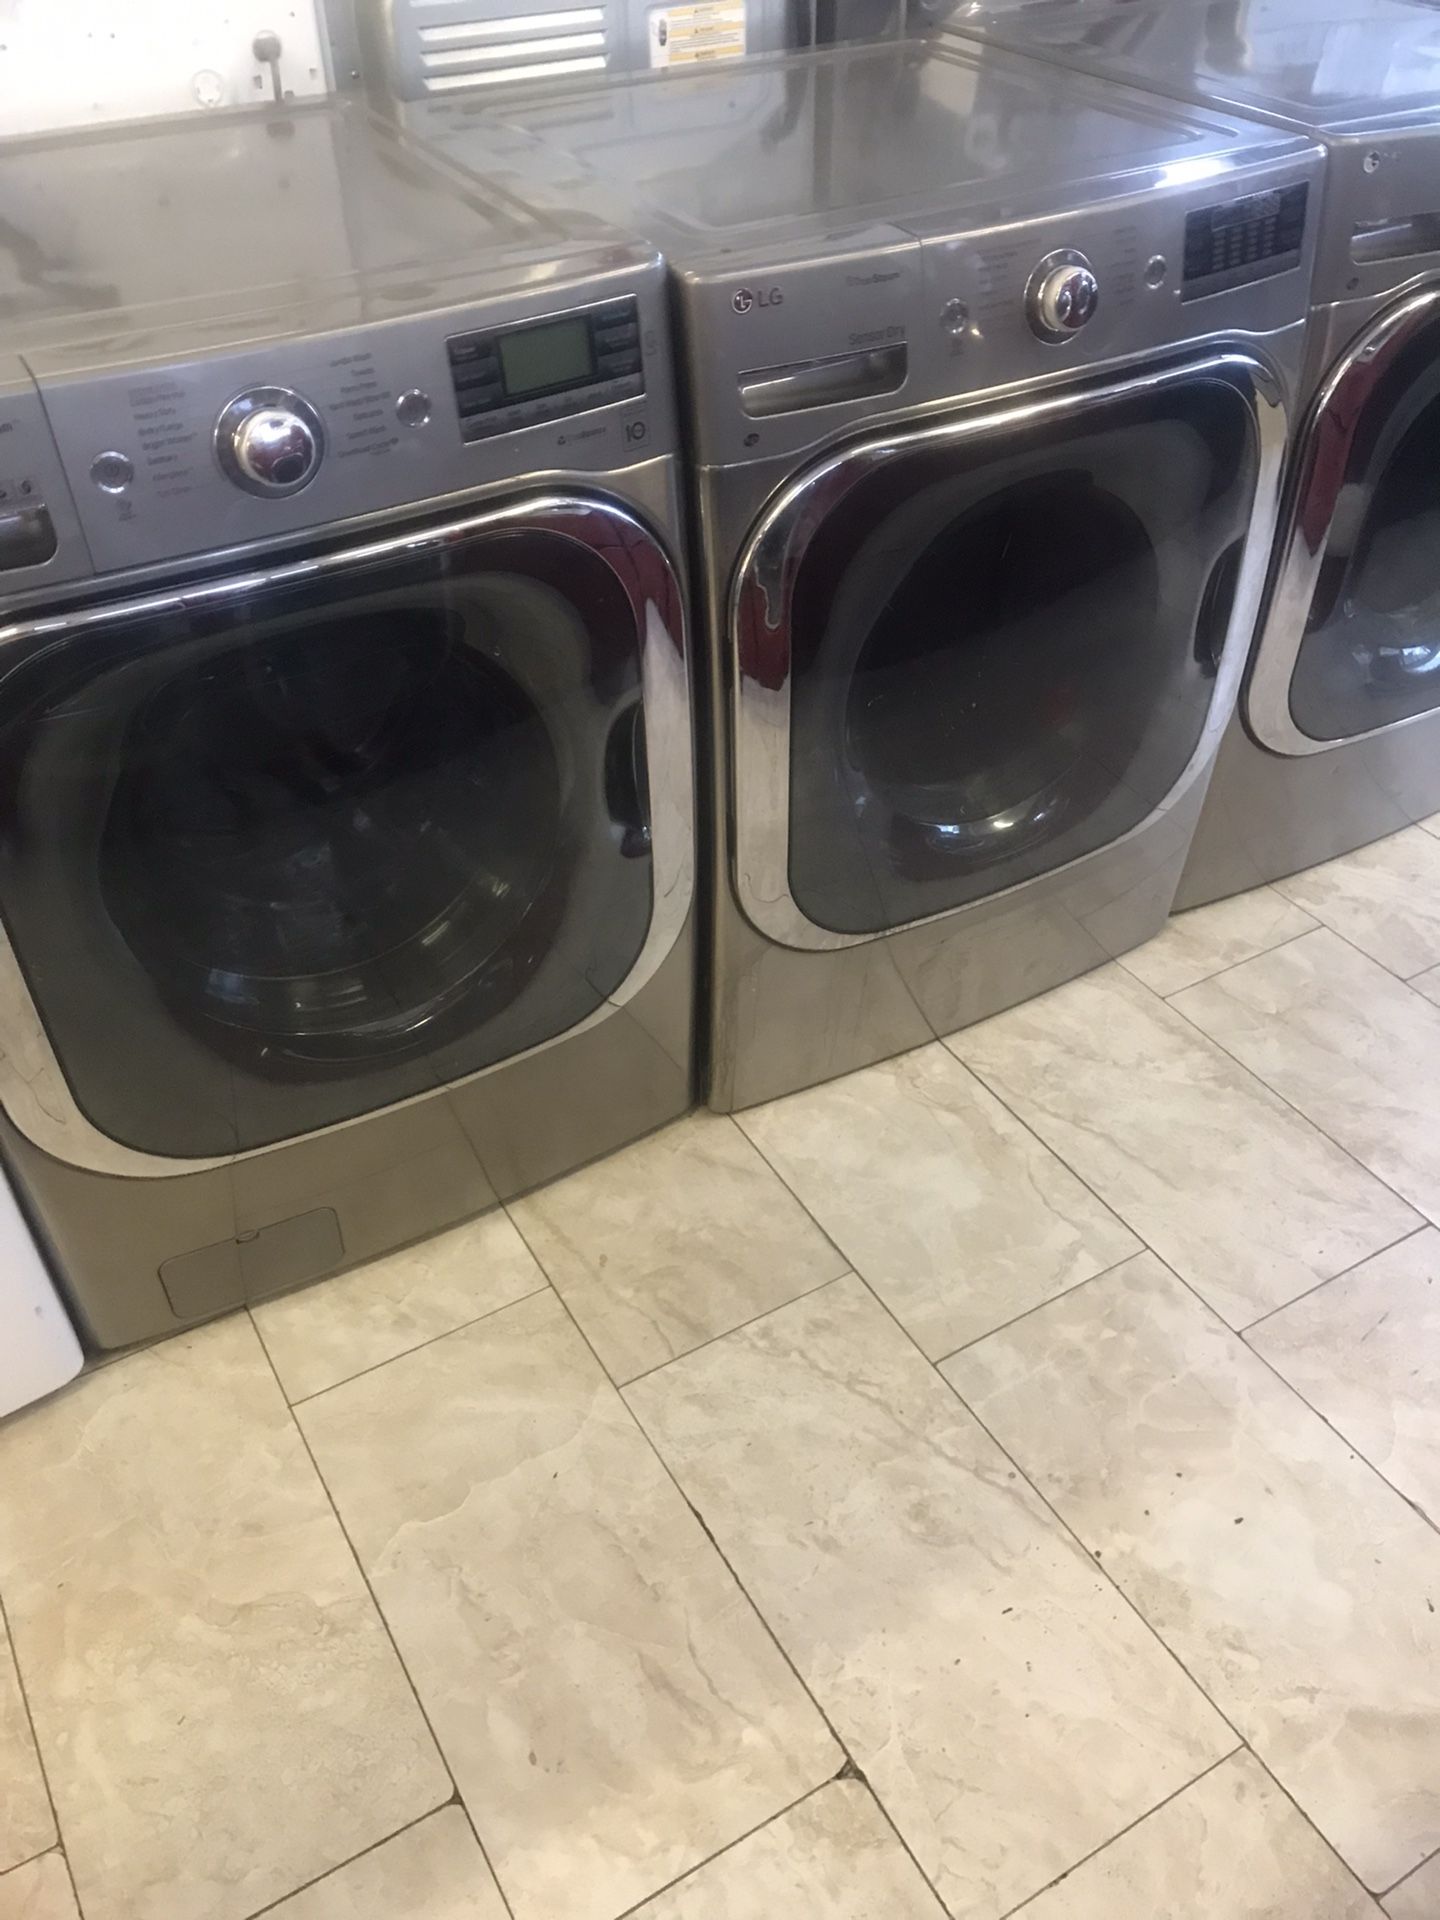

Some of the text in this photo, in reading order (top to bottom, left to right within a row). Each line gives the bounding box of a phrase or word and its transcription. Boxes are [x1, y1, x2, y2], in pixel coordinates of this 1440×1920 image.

[758, 287, 784, 308] LG
[886, 325, 906, 340] Dry
[625, 421, 647, 443] 10
